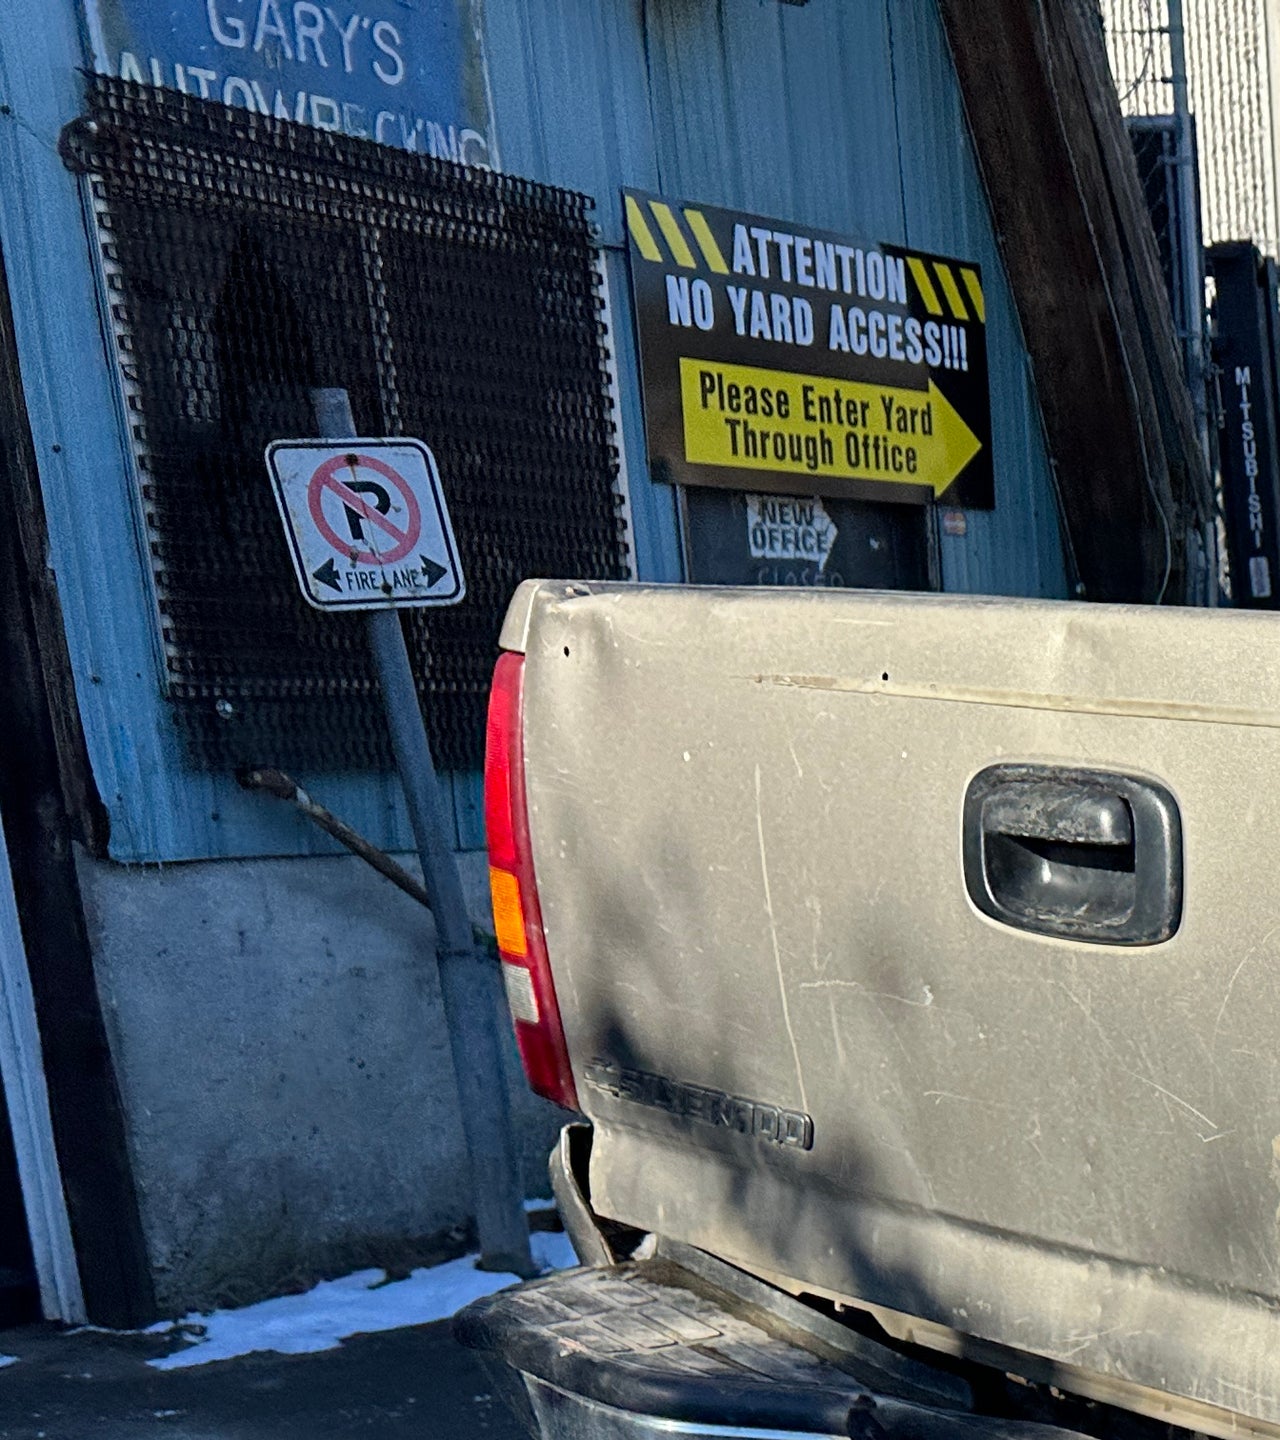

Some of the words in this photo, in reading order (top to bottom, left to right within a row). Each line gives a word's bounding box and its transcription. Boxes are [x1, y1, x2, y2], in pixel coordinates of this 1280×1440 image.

[206, 0, 404, 86] GARY'S
[732, 222, 907, 305] ATTENTION
[665, 274, 715, 331] NO
[725, 284, 814, 347] YARD
[828, 303, 969, 372] ACCESS!!!
[699, 369, 790, 420] Please
[803, 385, 871, 428] Enter
[880, 398, 934, 437] Yard
[725, 417, 835, 471] Through
[845, 430, 918, 474] Office
[1235, 365, 1264, 549] MITSUBISHI
[751, 522, 829, 552] OFFICE
[757, 500, 815, 527] NEW
[345, 570, 380, 591] FIRE
